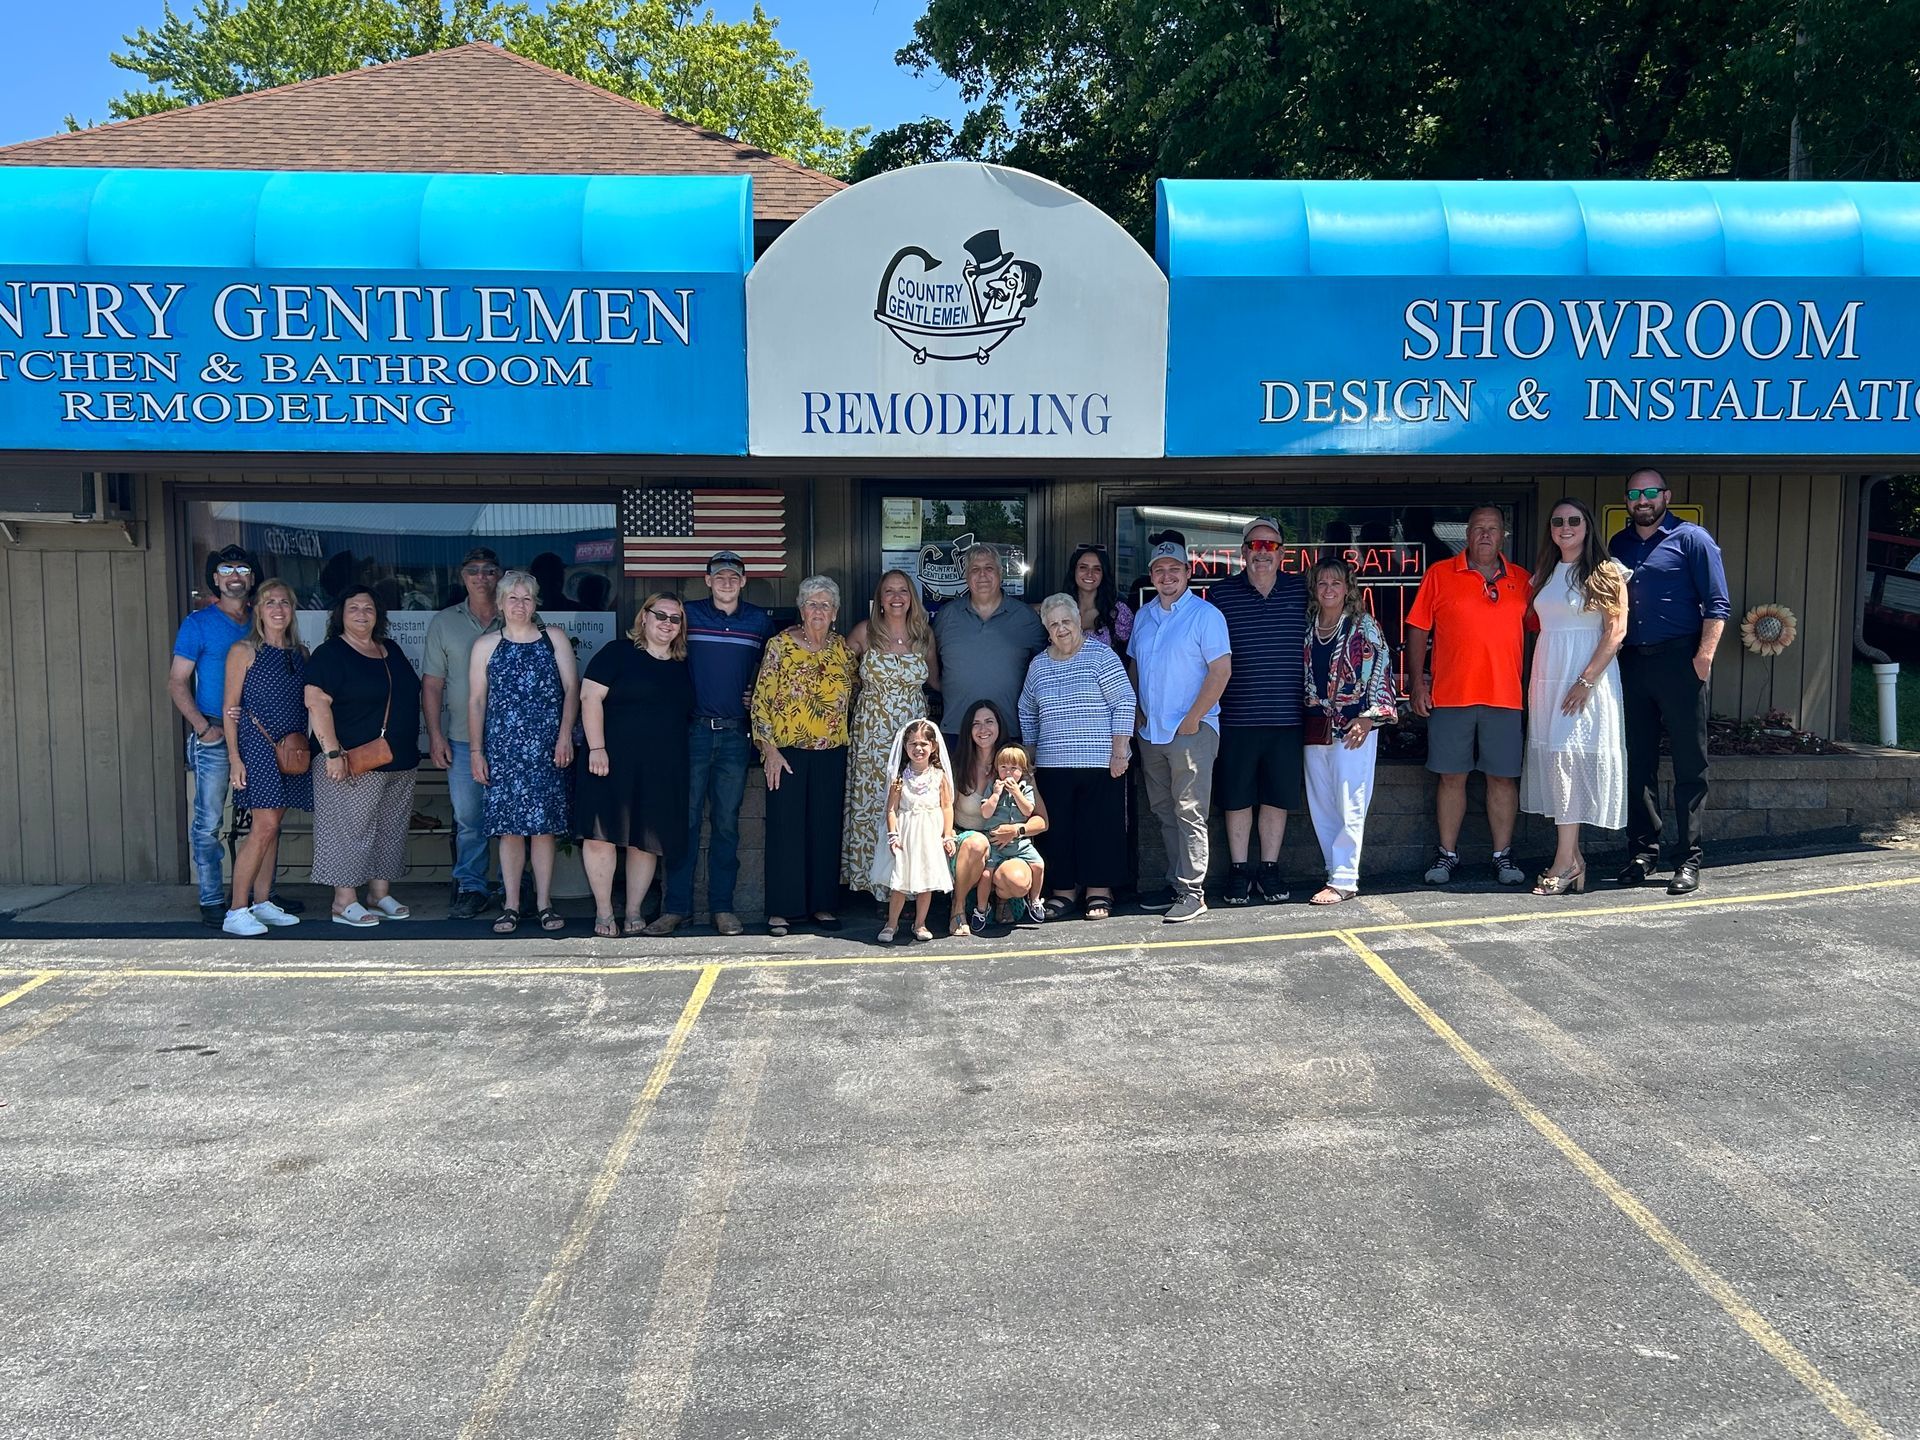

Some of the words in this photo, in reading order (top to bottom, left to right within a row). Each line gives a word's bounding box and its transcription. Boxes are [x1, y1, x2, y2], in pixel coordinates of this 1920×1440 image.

[897, 276, 963, 303] COUNTRY
[213, 283, 695, 346] GENTLEMEN
[889, 295, 969, 325] GENTLEMEN
[1403, 298, 1865, 361] SHOWROOM
[200, 352, 244, 384] &
[262, 353, 593, 387] BATHROOM
[60, 391, 455, 425] REMODELING
[800, 391, 1113, 436] REMODELING
[1259, 377, 1476, 425] DESIGN
[1507, 377, 1552, 421] &
[1584, 378, 1920, 422] INSTALLATI
[922, 570, 958, 580] GENTLEMEN
[926, 562, 954, 573] COUNTRY
[1191, 548, 1319, 574] KITEN
[1343, 548, 1419, 573] BATH
[568, 620, 604, 633] Lighting
